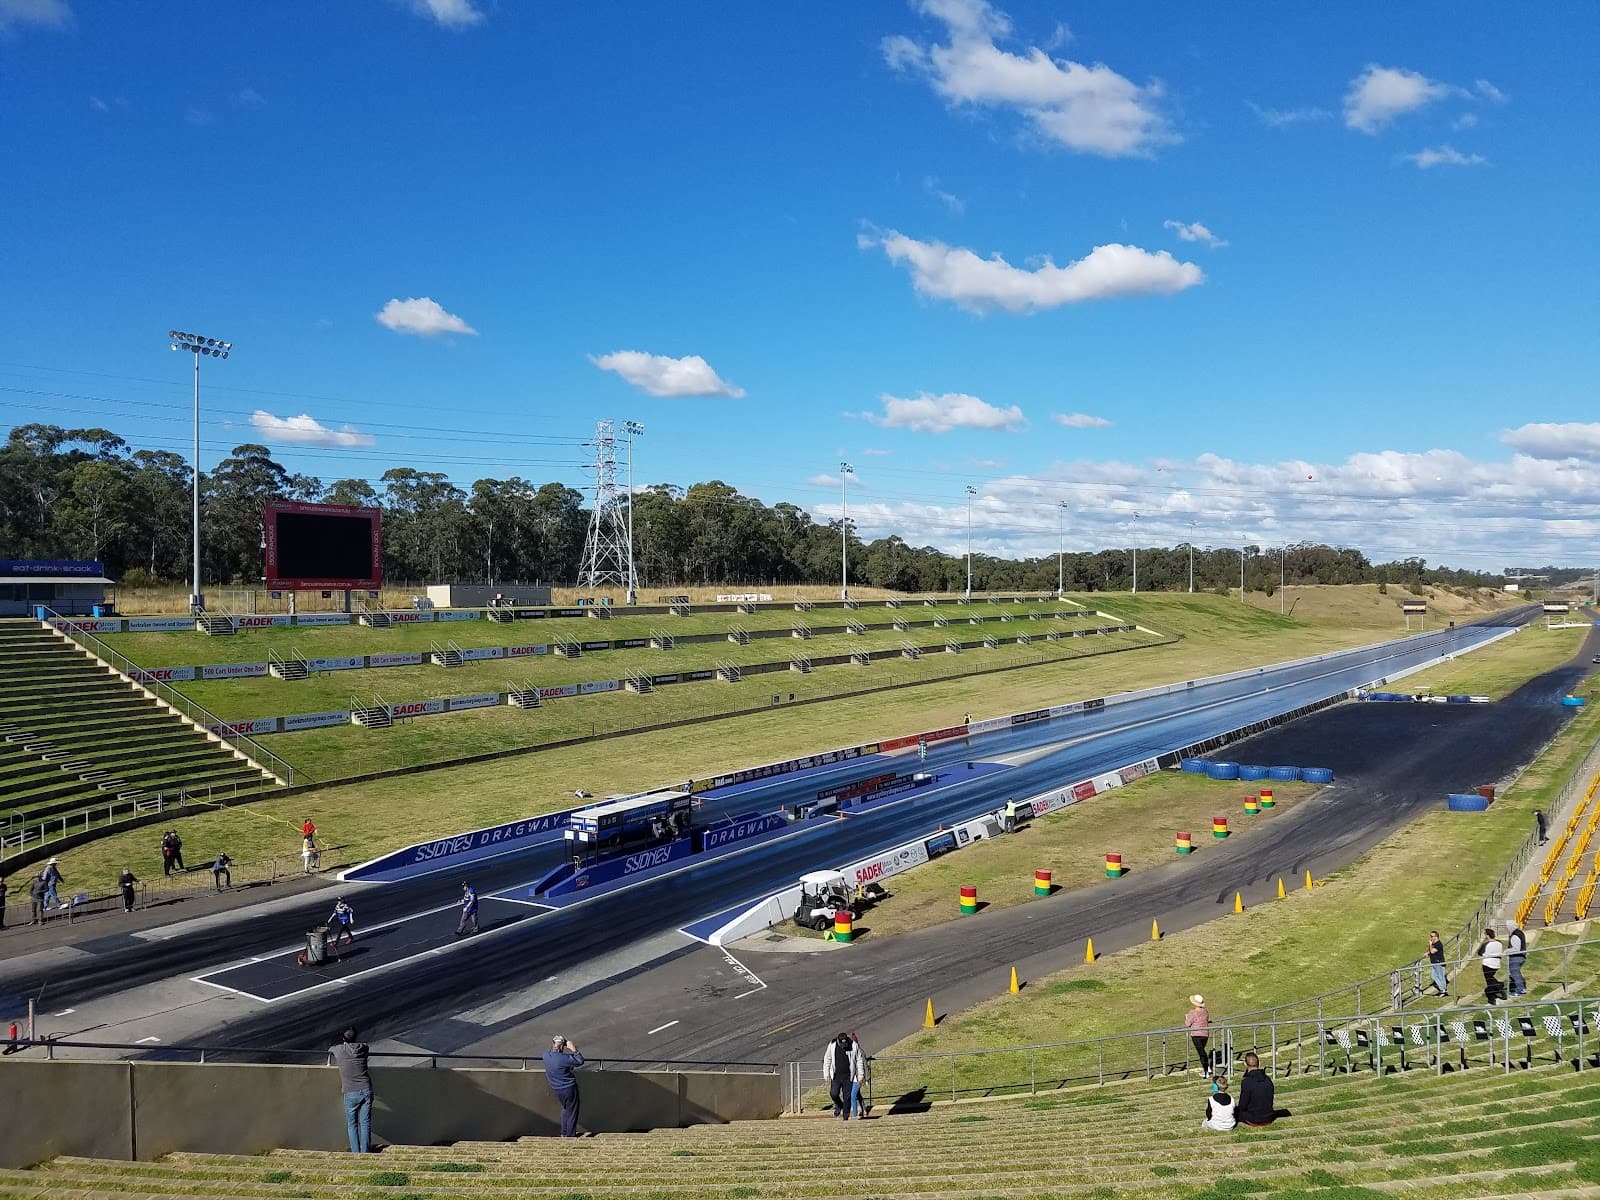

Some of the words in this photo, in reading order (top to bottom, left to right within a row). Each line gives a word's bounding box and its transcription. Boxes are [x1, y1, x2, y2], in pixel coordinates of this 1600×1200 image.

[239, 617, 273, 627] SADEK
[393, 612, 420, 621] SADEK
[511, 647, 535, 655] SADEK
[227, 666, 243, 674] Under
[256, 664, 267, 672] Roof
[127, 669, 173, 682] SADEK
[540, 687, 564, 698] SADEK
[393, 703, 427, 715] SADEK
[210, 722, 255, 737] SADEK
[710, 816, 773, 846] DRAGWAY
[415, 834, 474, 862] SYDNEY
[480, 815, 561, 845] DRAGWAY
[624, 846, 672, 874] SYDNEY
[856, 862, 884, 883] SADEK
